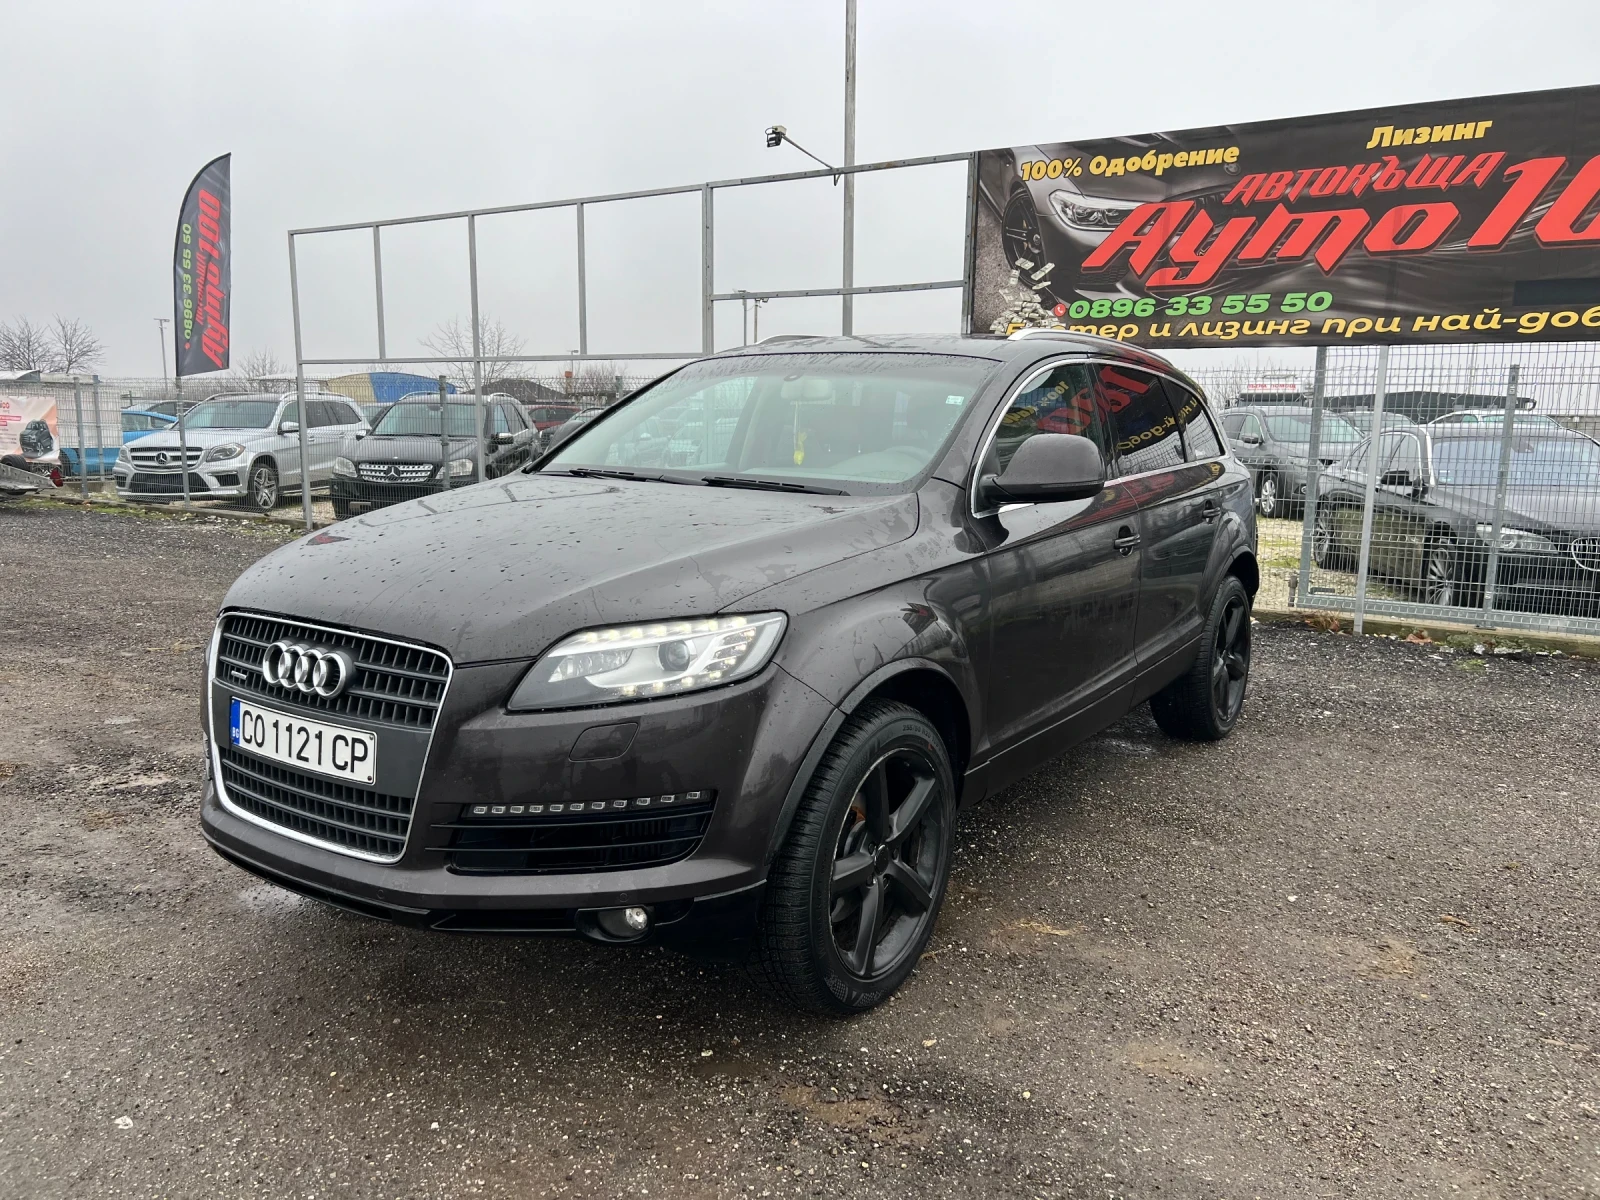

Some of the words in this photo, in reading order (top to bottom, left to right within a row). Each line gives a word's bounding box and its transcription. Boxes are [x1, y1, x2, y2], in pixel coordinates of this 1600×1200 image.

[1366, 120, 1493, 149] Лизинг
[1021, 158, 1082, 181] 100%
[1088, 146, 1240, 177] Одобрение
[1221, 151, 1506, 206] АВТОКЪЩА
[182, 223, 192, 245] 50
[198, 188, 222, 260] 100
[182, 248, 192, 269] 55
[1080, 200, 1462, 287] Ауто
[182, 273, 192, 295] 33
[183, 299, 193, 340] 0896
[1068, 299, 1156, 319] 0896
[1165, 296, 1213, 316] 33
[1220, 294, 1271, 315] 55
[1280, 291, 1333, 313] 50
[1149, 322, 1171, 337] и
[1178, 318, 1311, 339] лизинг
[1321, 315, 1402, 338] при
[242, 710, 266, 748] CO
[273, 719, 323, 766] 1121
[332, 734, 368, 773] CP
